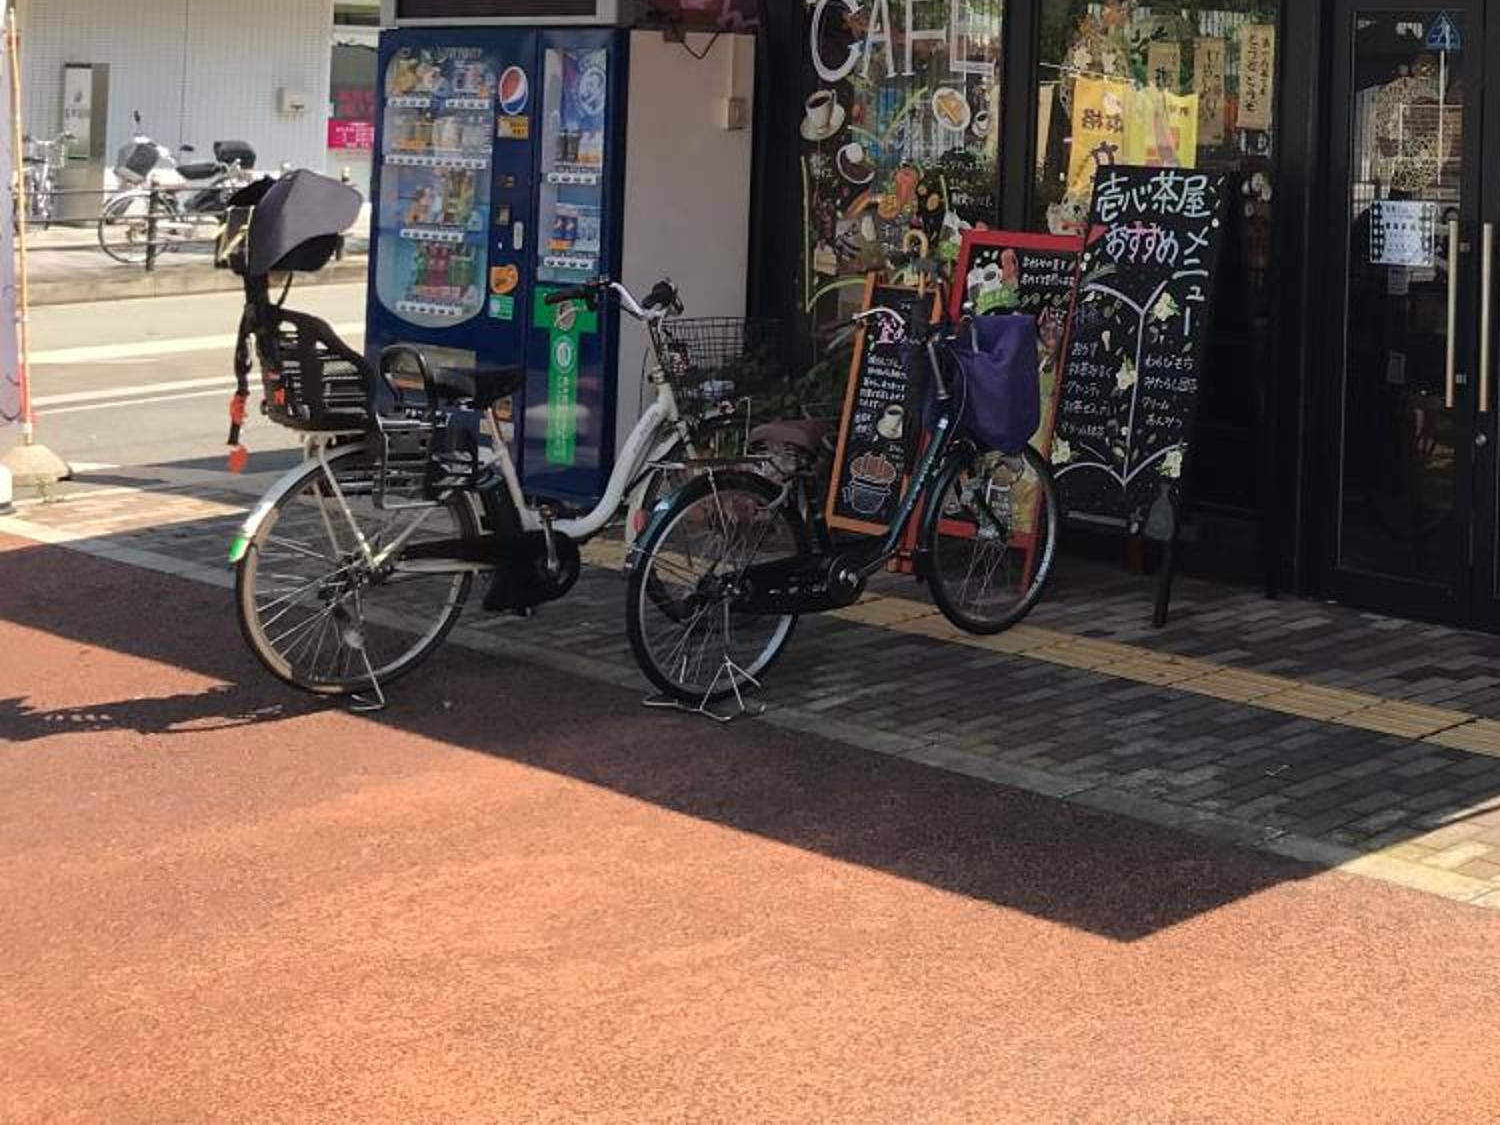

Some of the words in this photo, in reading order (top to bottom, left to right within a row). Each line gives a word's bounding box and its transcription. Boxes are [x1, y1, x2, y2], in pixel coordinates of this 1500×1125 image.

[1105, 221, 1180, 267] おすすめ
[1172, 226, 1209, 336] メニュー
